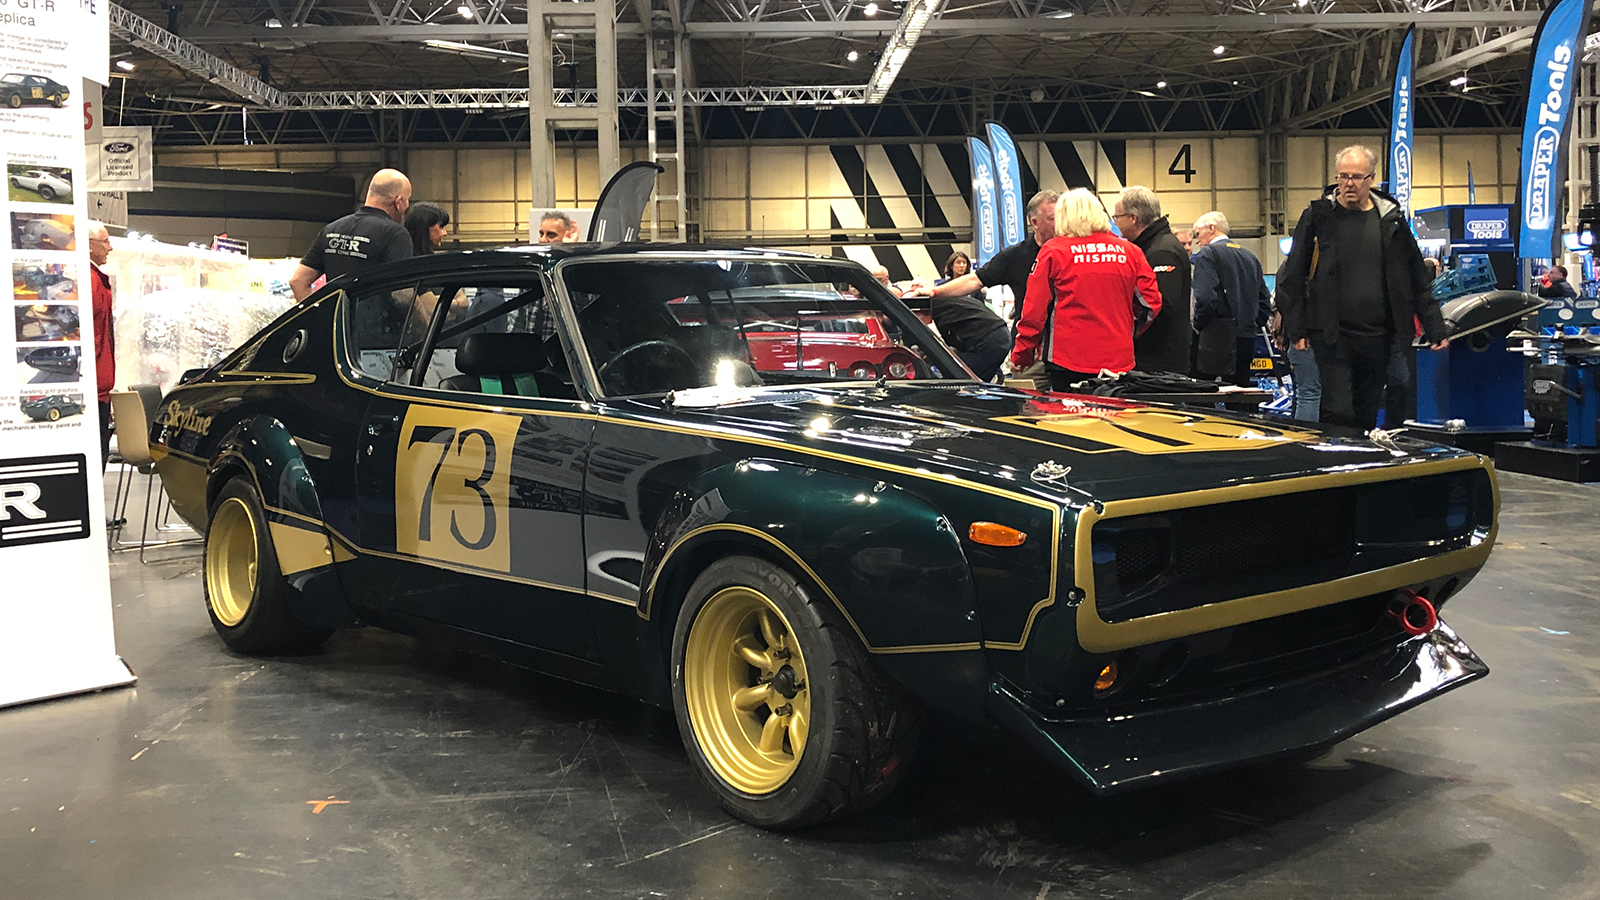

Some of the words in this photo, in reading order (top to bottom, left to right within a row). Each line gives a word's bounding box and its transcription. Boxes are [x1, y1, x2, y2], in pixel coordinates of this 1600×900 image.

[1538, 44, 1572, 125] Tools
[109, 142, 130, 152] Ford
[1168, 143, 1197, 184] 4
[1530, 136, 1555, 221] DRAPER
[1471, 222, 1503, 230] DRAPER
[1472, 229, 1503, 239] Tools
[1070, 243, 1126, 254] NISSAN
[56, 422, 70, 430] paint
[162, 399, 212, 438] Skyline
[0, 482, 47, 520] R
[407, 425, 498, 551] 73
